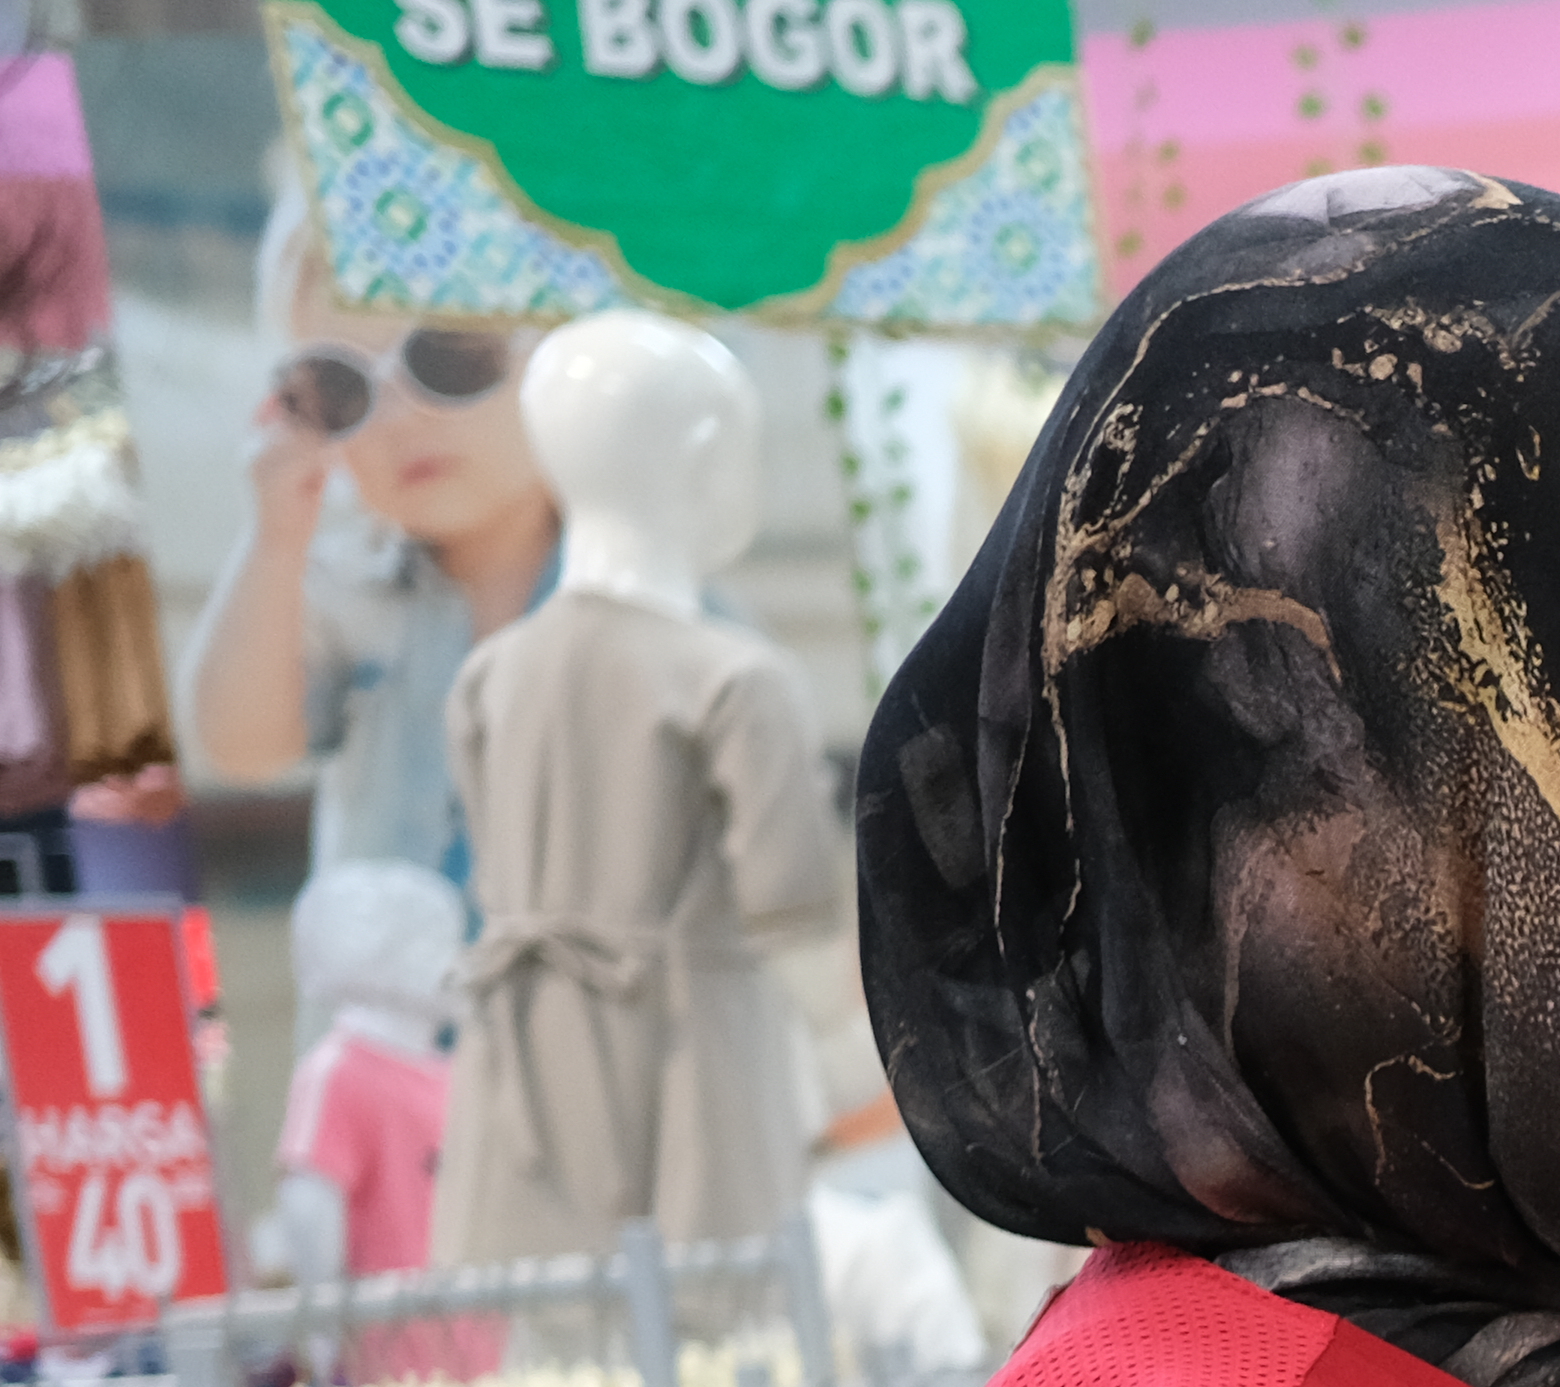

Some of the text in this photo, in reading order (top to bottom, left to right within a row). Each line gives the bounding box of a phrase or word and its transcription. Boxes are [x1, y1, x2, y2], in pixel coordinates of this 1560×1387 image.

[395, 0, 977, 104] SE BOGOR
[34, 913, 128, 1099] 1
